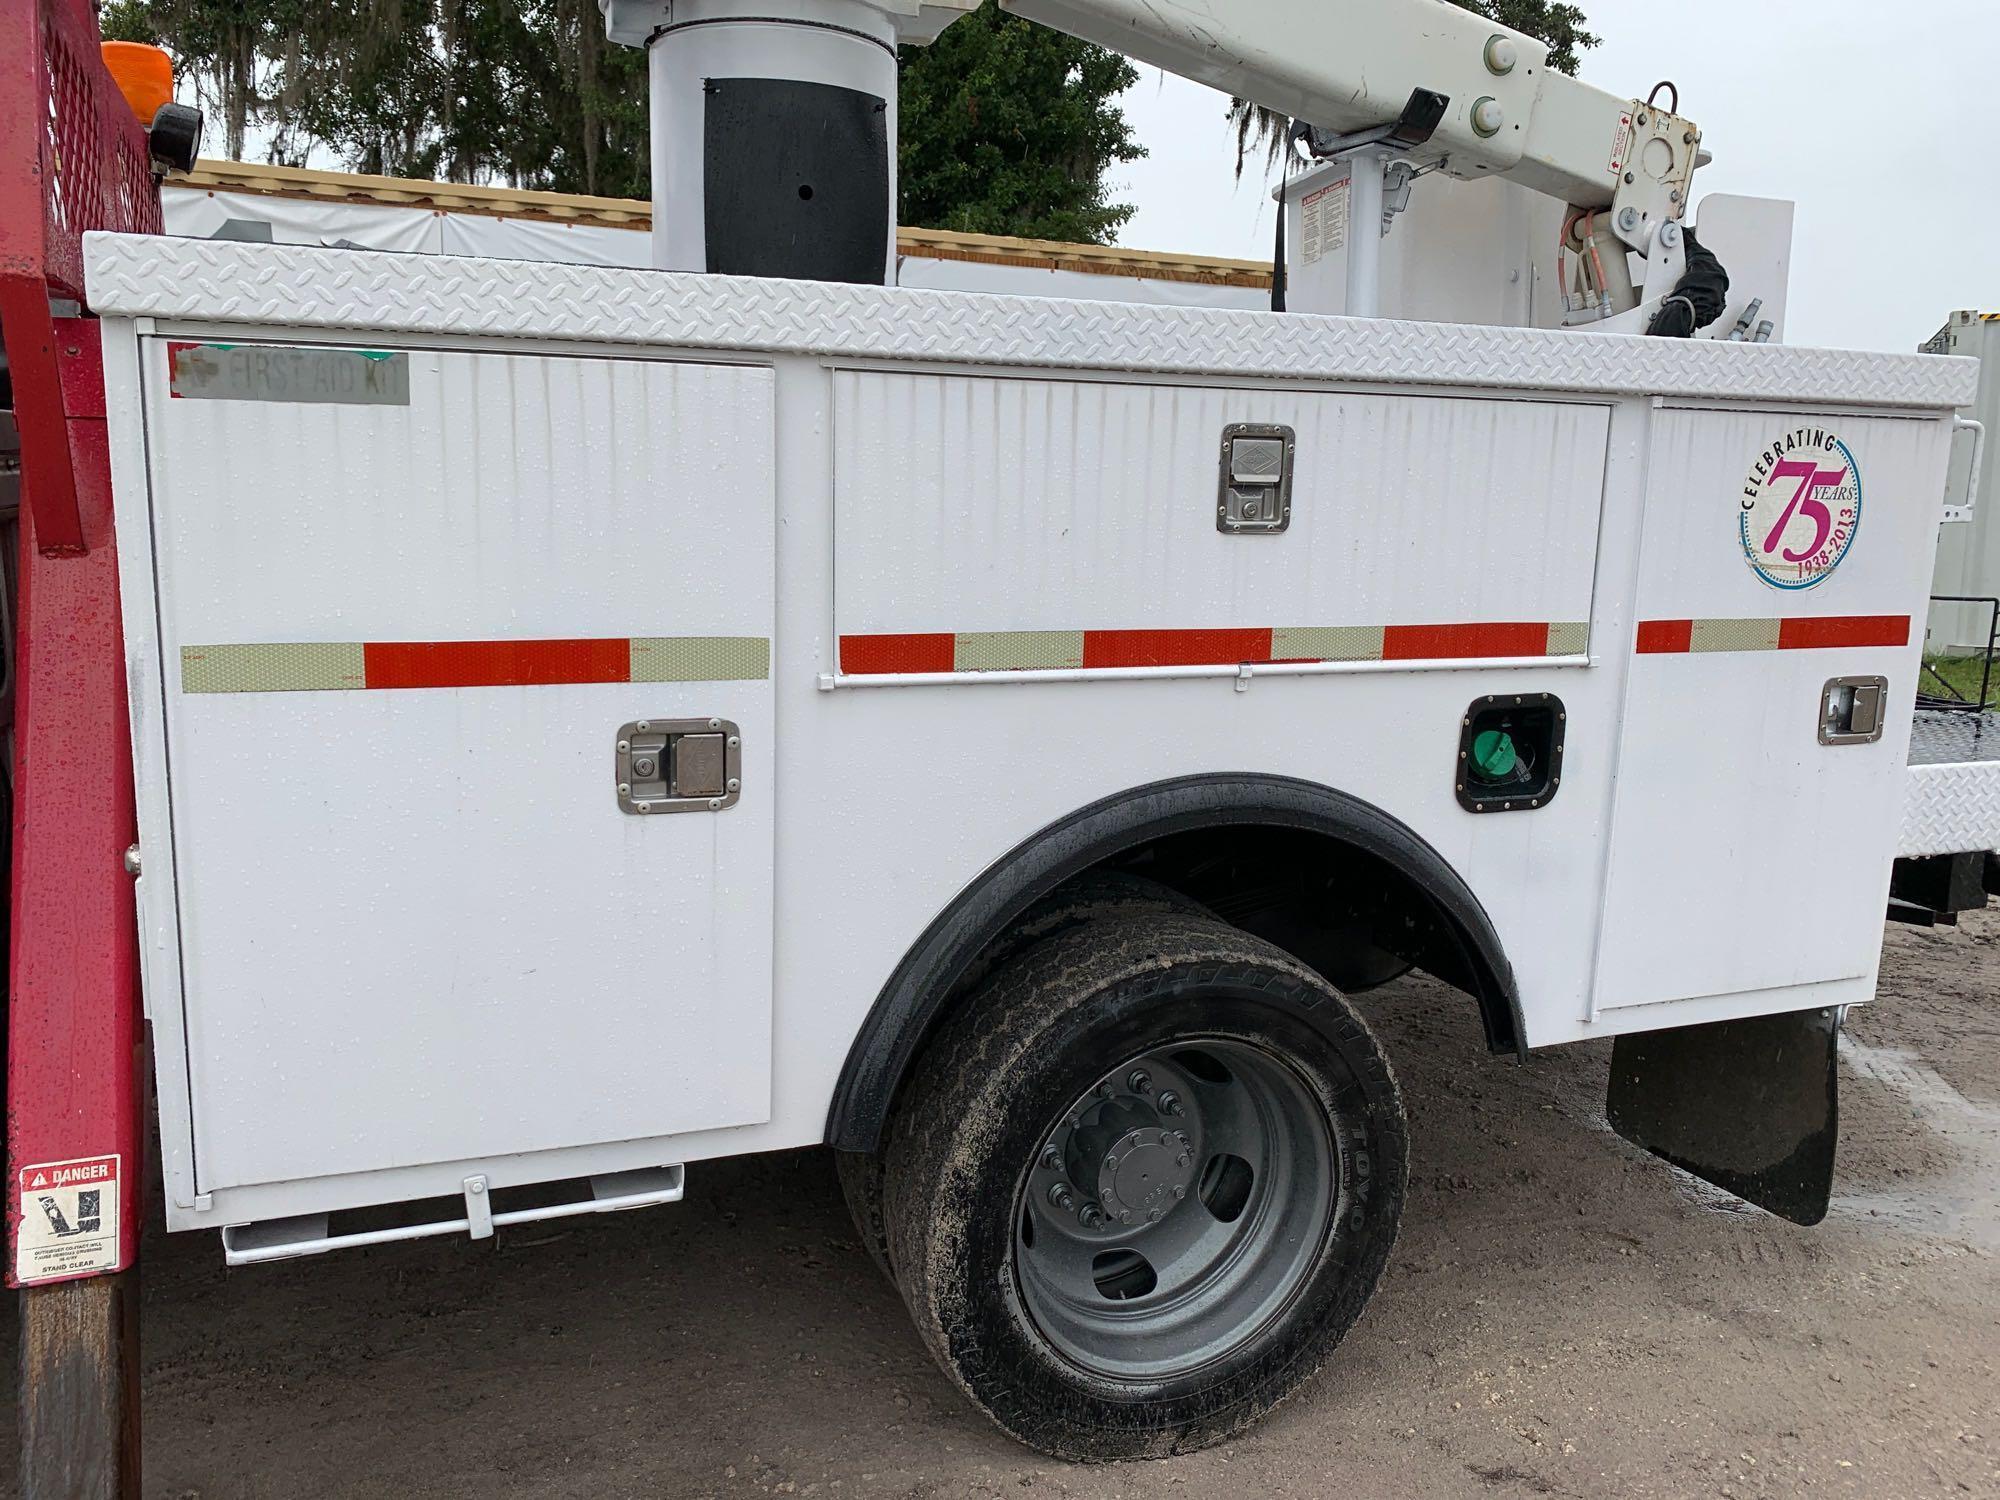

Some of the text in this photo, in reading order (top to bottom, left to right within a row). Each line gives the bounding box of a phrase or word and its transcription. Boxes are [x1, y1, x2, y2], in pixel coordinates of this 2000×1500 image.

[230, 351, 402, 395] FIRST AID KIT
[1741, 428, 1836, 511] CELEBRATING
[1814, 486, 1855, 501] YEARS
[1763, 456, 1848, 563] 75
[1798, 508, 1856, 579] 1938-2013
[52, 1164, 109, 1184] DANGER
[1350, 1121, 1371, 1233] TOYO
[42, 1264, 67, 1273] STAND
[69, 1260, 94, 1269] CLEAR
